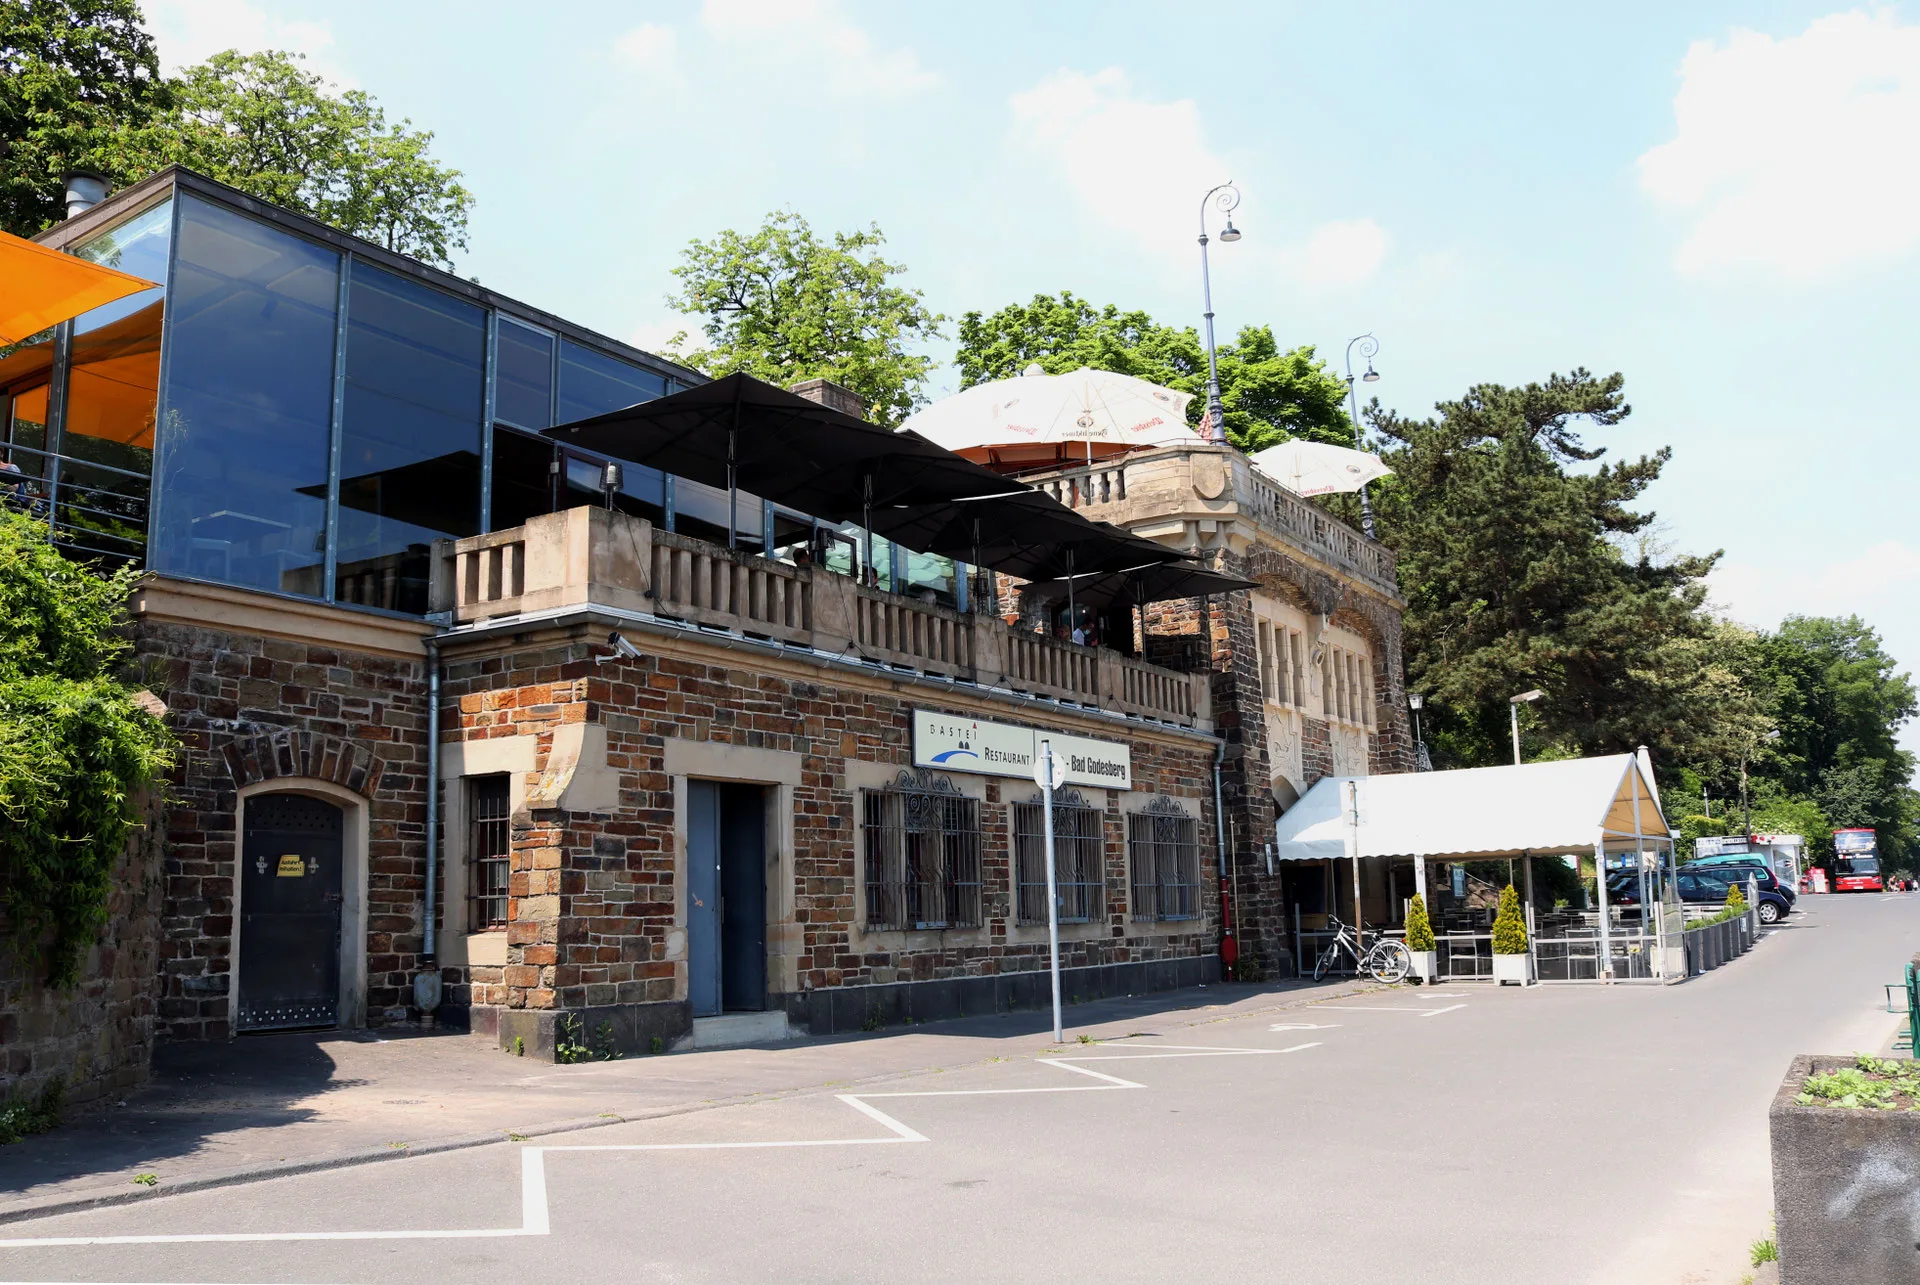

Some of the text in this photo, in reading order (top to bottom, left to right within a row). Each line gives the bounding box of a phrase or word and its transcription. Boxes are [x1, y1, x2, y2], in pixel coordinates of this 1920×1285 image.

[930, 723, 977, 741] BASTEI
[984, 746, 1030, 766] RESTAURANT
[1071, 754, 1086, 773] Bad
[1087, 756, 1126, 780] Godesberg
